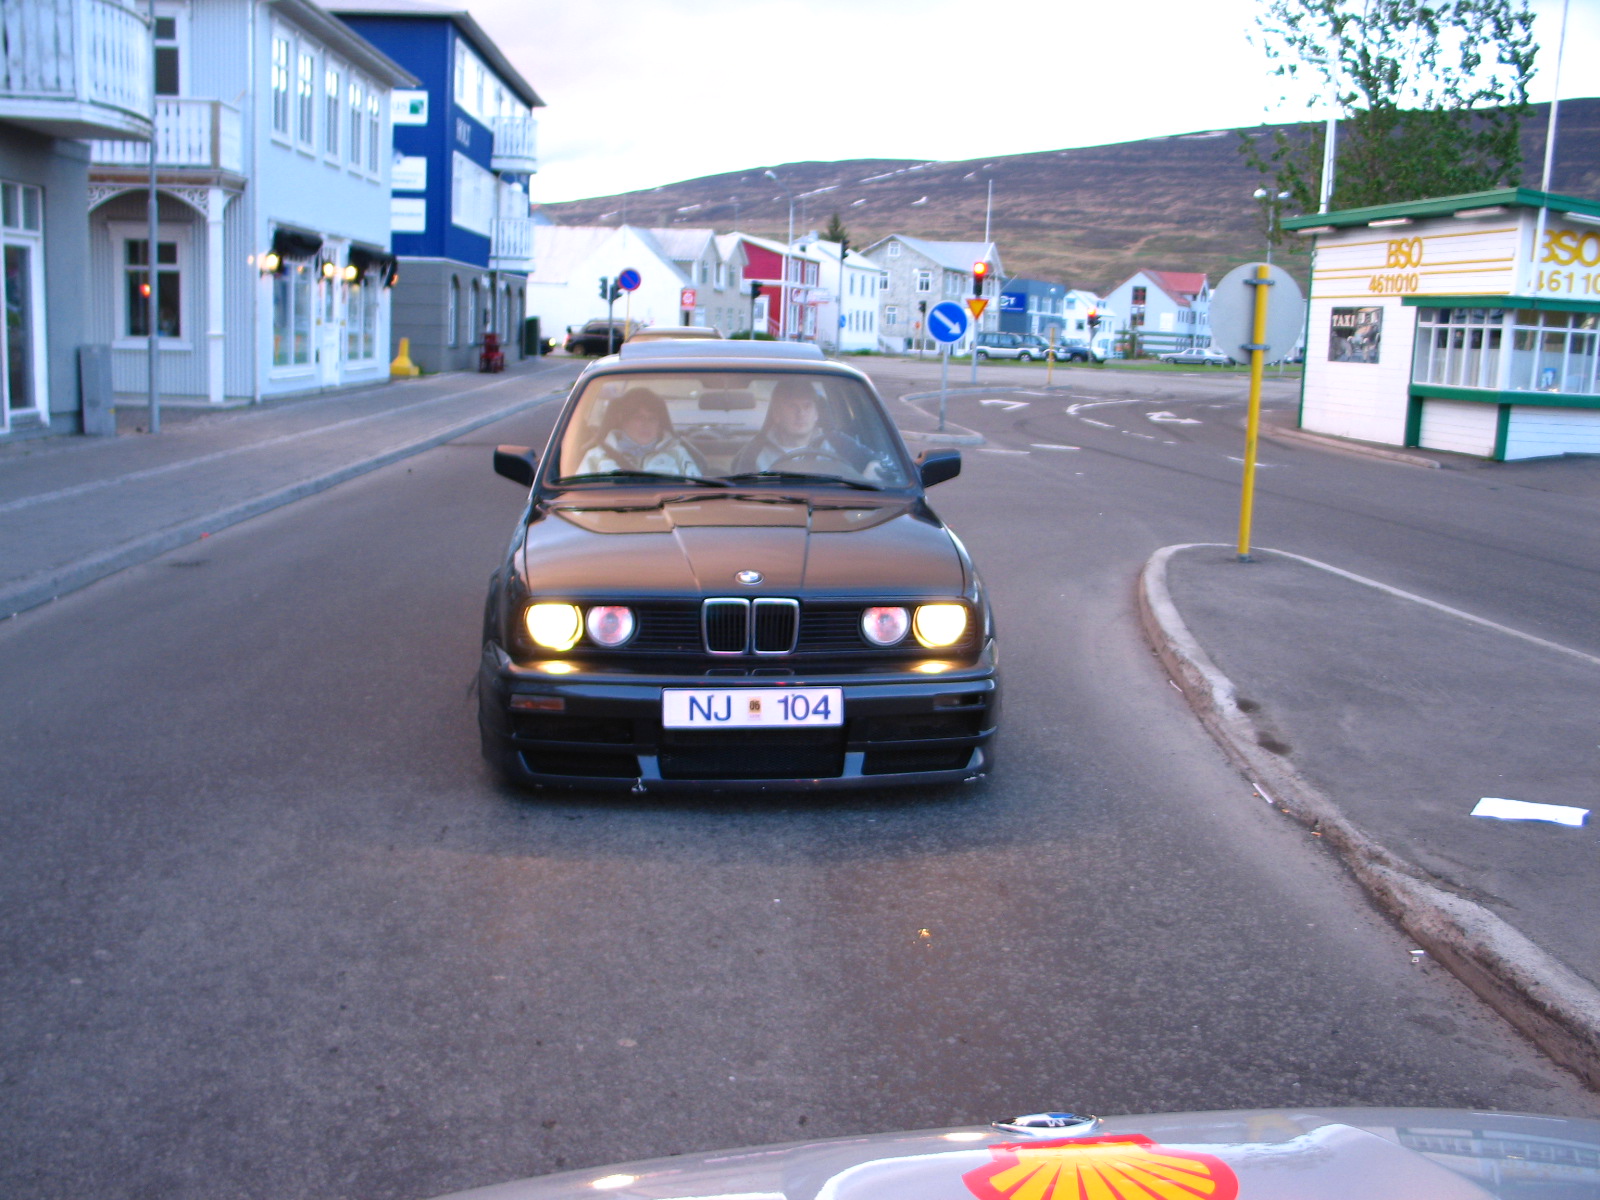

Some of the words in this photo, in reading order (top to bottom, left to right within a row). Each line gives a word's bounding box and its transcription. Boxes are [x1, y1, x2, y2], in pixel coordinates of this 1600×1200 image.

[1386, 236, 1422, 269] BSO
[1530, 229, 1600, 267] BSO
[1368, 273, 1419, 293] 4611010
[1332, 314, 1355, 327] TAXI
[689, 695, 732, 721] NJ
[777, 694, 832, 721] 104
